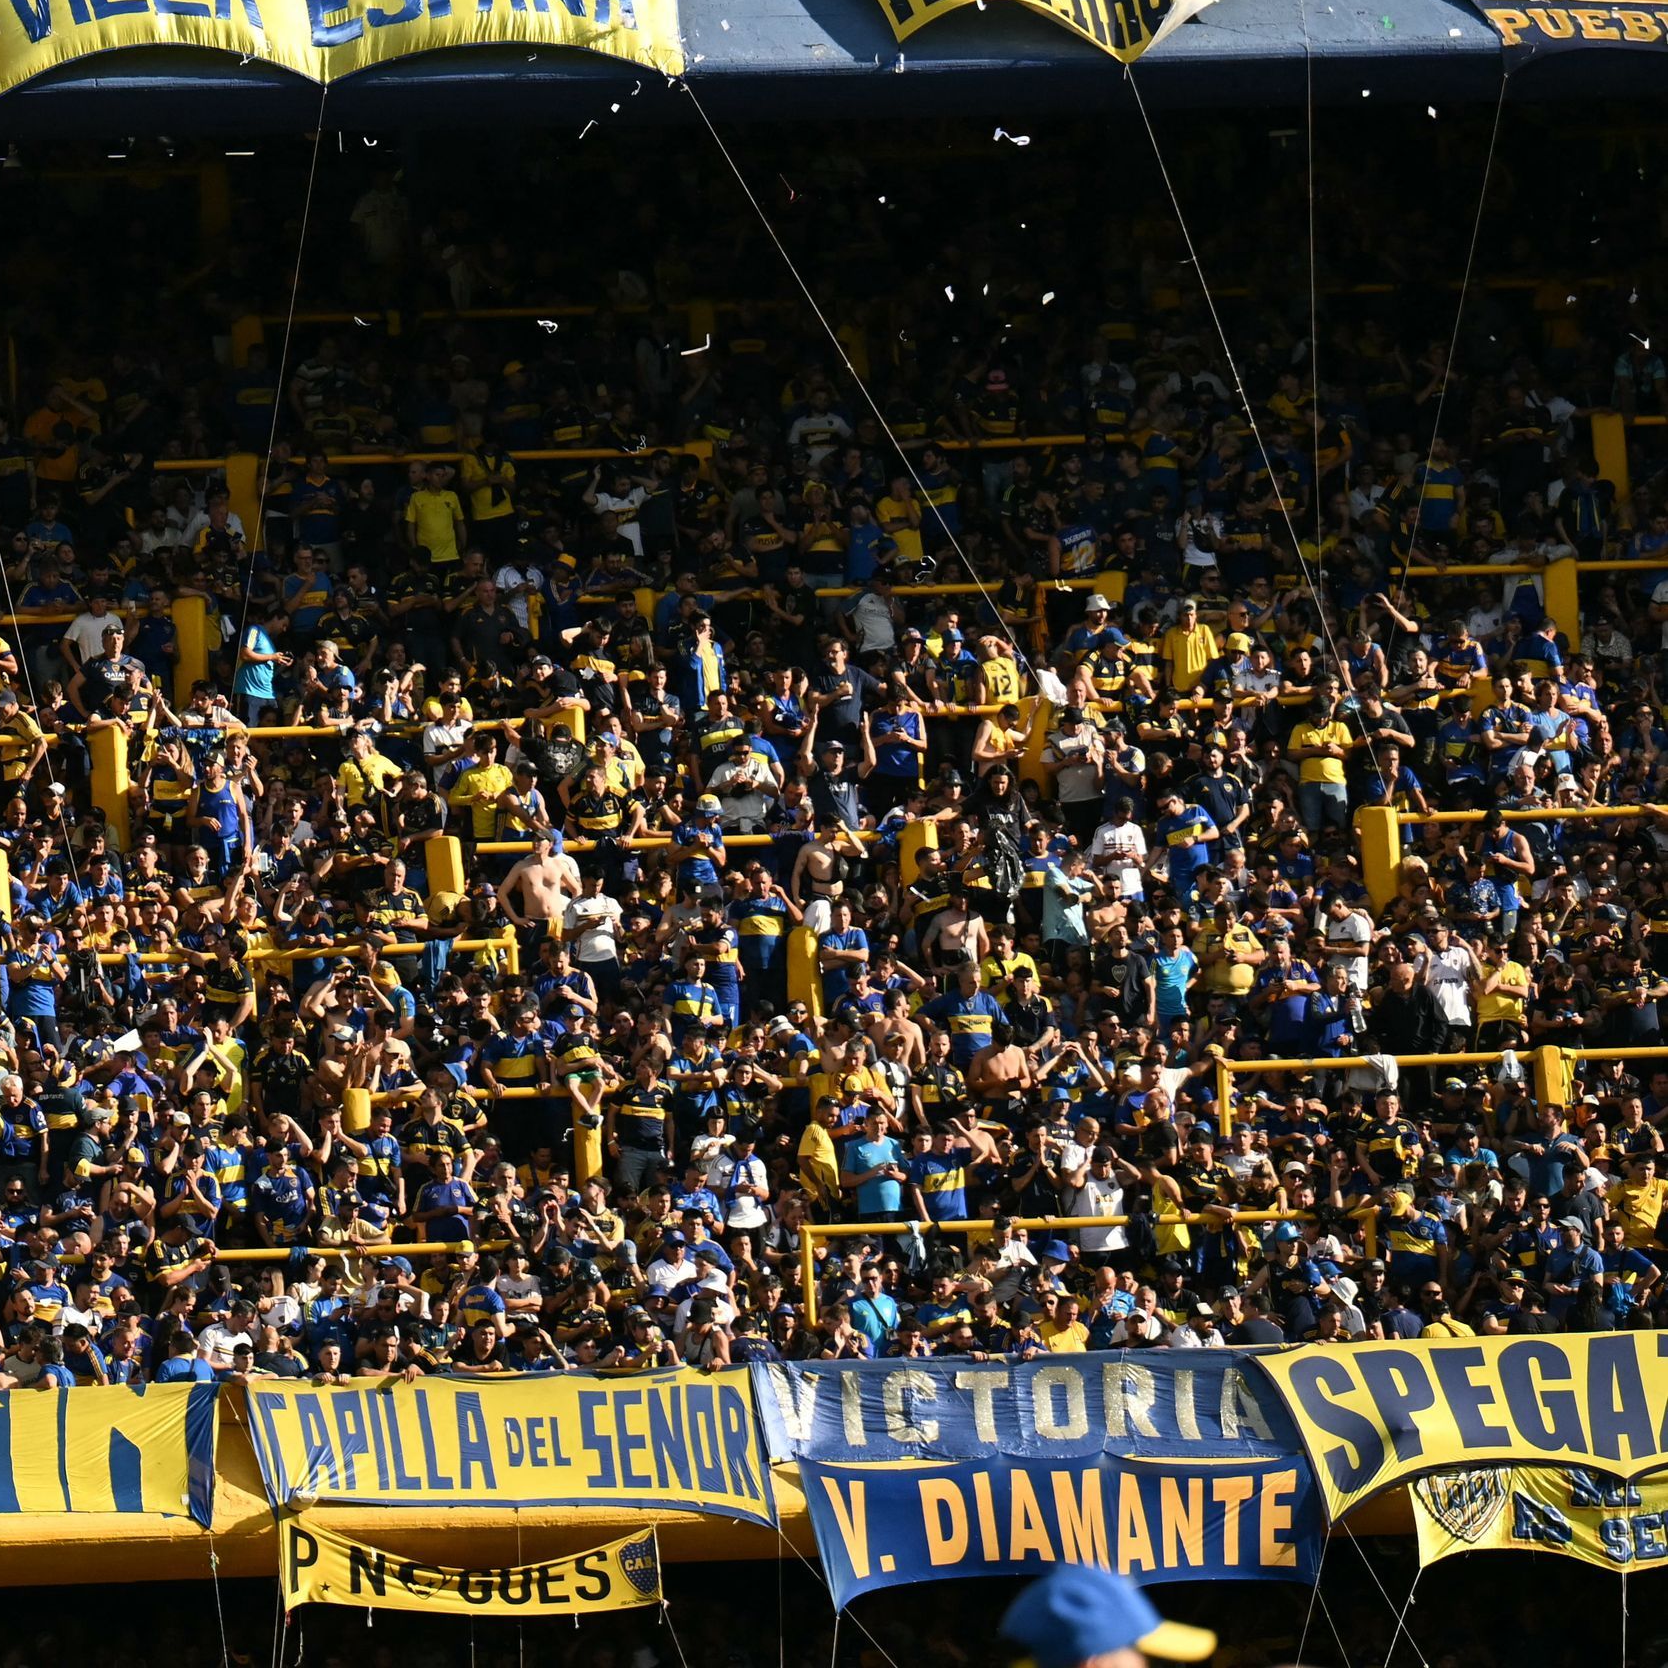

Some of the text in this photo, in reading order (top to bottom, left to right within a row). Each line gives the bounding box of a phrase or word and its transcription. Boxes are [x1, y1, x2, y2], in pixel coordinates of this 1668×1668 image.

[1484, 5, 1668, 47] PUEB
[991, 674, 1013, 695] 12
[275, 1191, 299, 1204] QATAR
[507, 1416, 572, 1469] DEL
[578, 1375, 760, 1502] SEÑOR
[768, 1362, 1275, 1446] VICTORIA
[1292, 1333, 1668, 1494] SPEGA
[822, 1466, 1299, 1579] V. DIAMANTE
